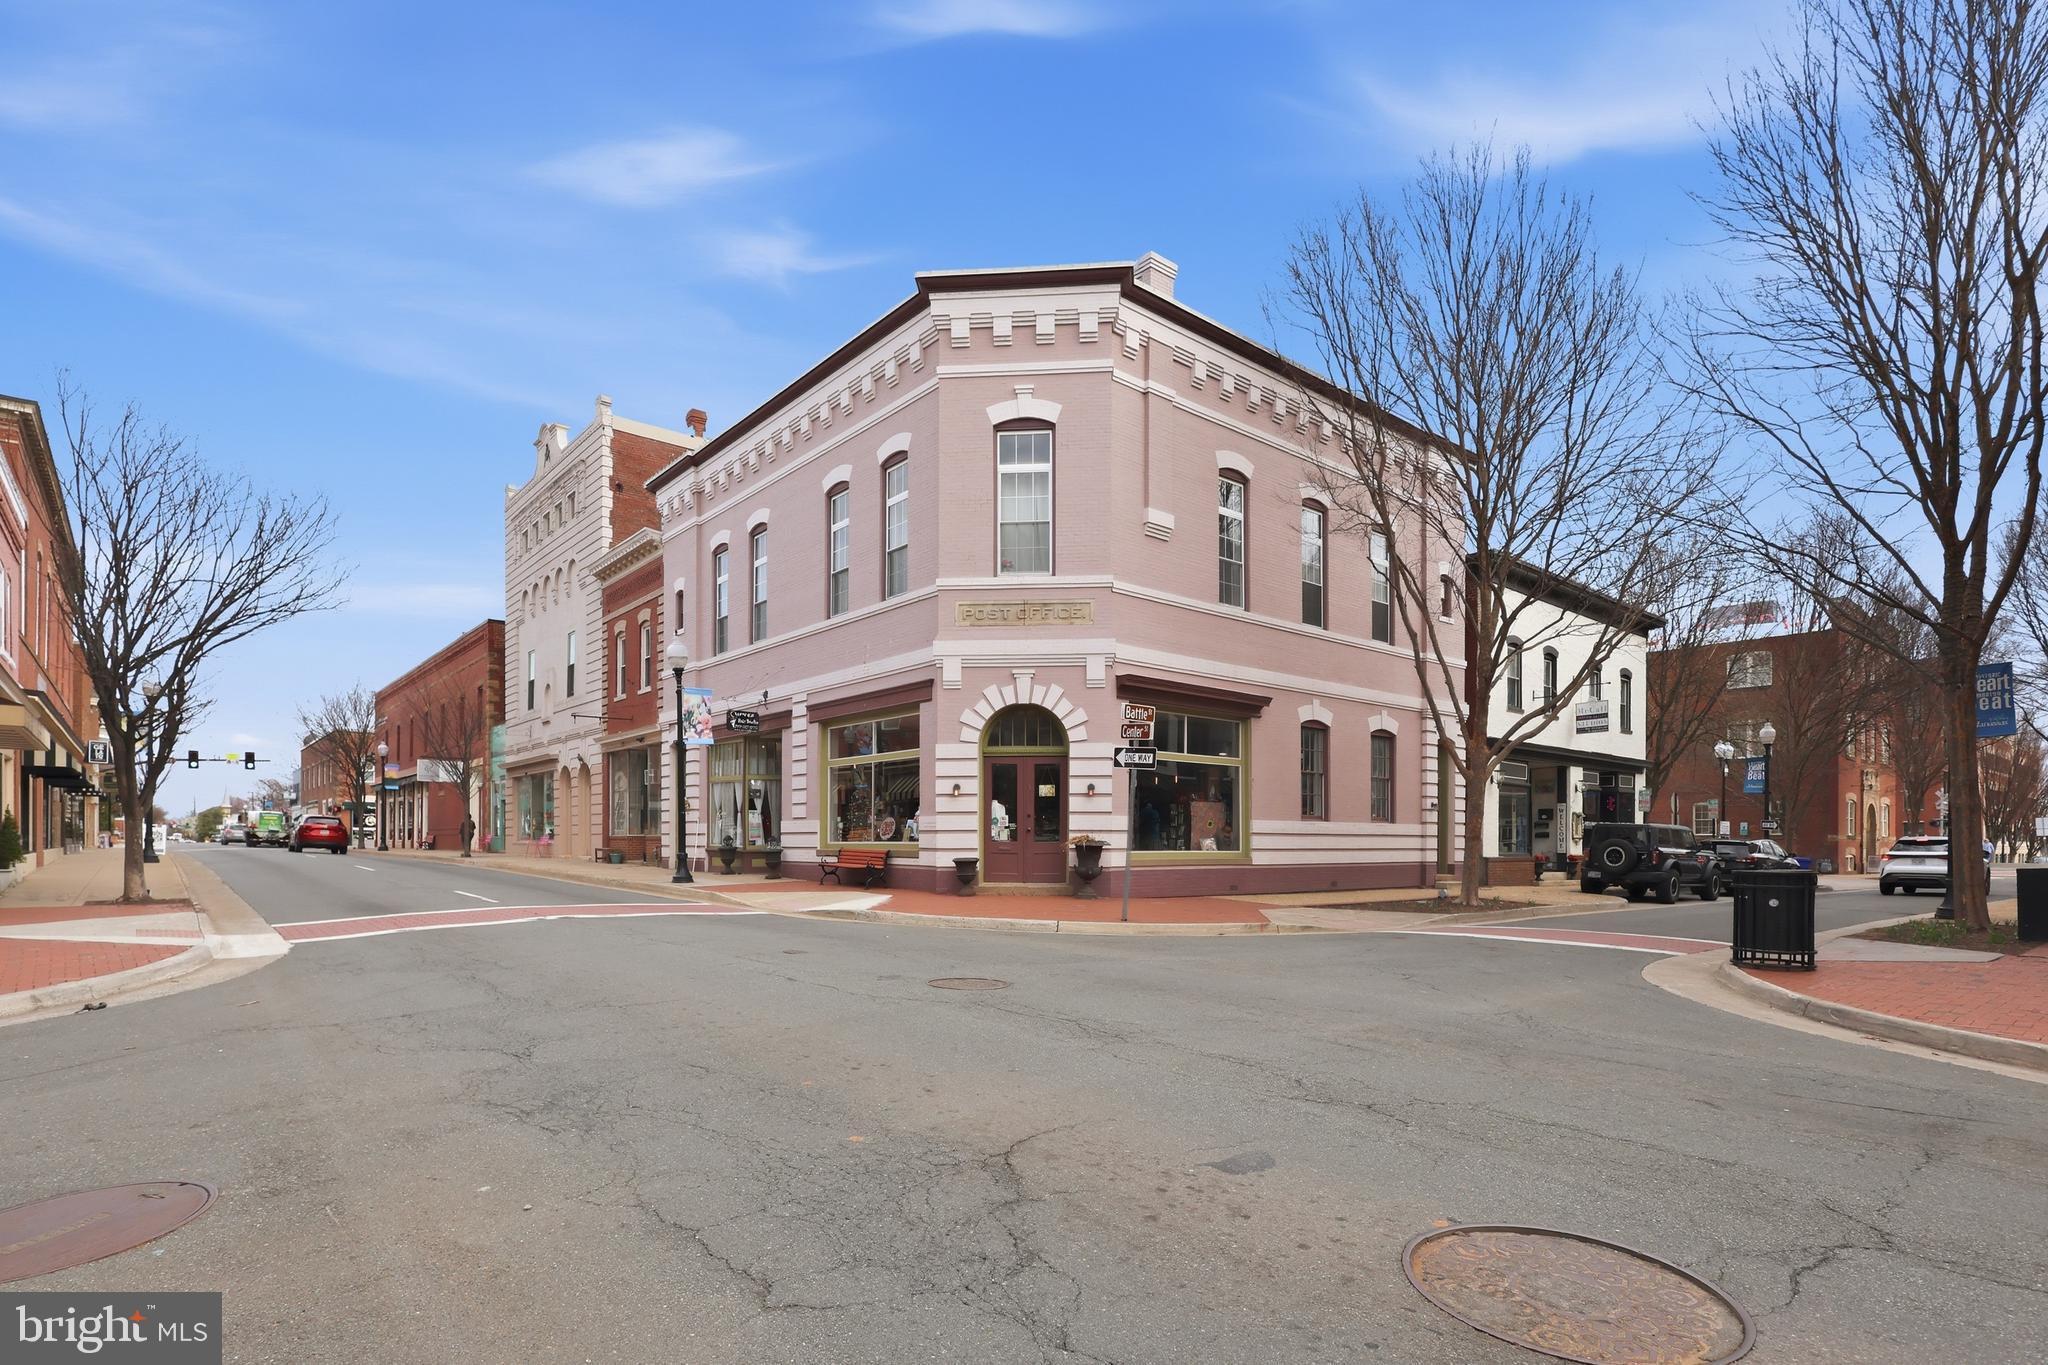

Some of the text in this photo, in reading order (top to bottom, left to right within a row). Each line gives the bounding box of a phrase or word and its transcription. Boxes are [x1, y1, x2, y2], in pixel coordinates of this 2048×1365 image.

[961, 608, 1011, 621] POST
[1976, 674, 2011, 692] eart
[1979, 693, 2012, 710] eat
[1125, 706, 1148, 720] Battle
[1122, 725, 1144, 738] Center
[1138, 754, 1151, 762] WAY
